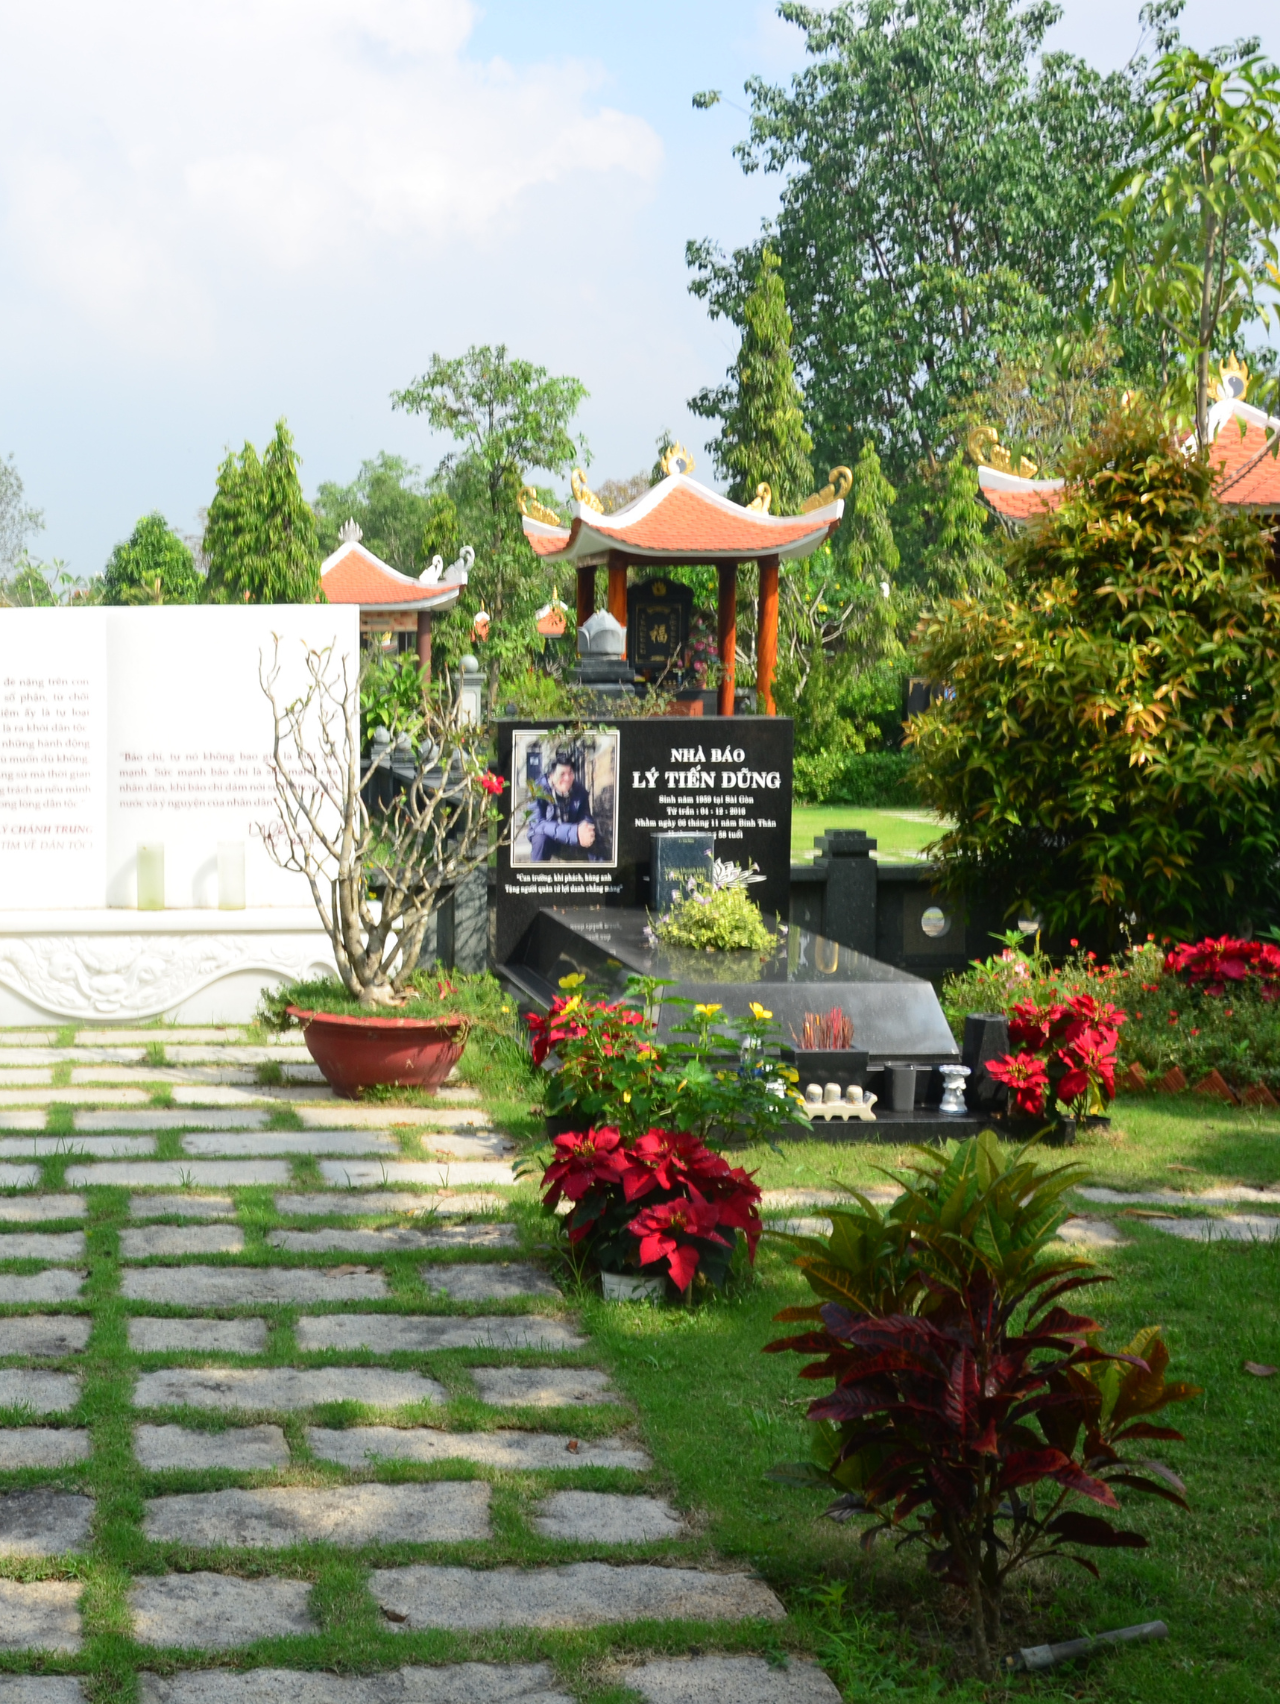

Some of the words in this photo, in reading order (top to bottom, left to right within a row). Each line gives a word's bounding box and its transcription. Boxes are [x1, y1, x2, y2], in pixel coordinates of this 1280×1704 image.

[670, 745, 706, 763] NHÀ
[710, 745, 745, 763] BÁO
[632, 767, 659, 788] LÝ
[664, 764, 716, 788] TIẾN
[721, 767, 781, 789] DŨNG
